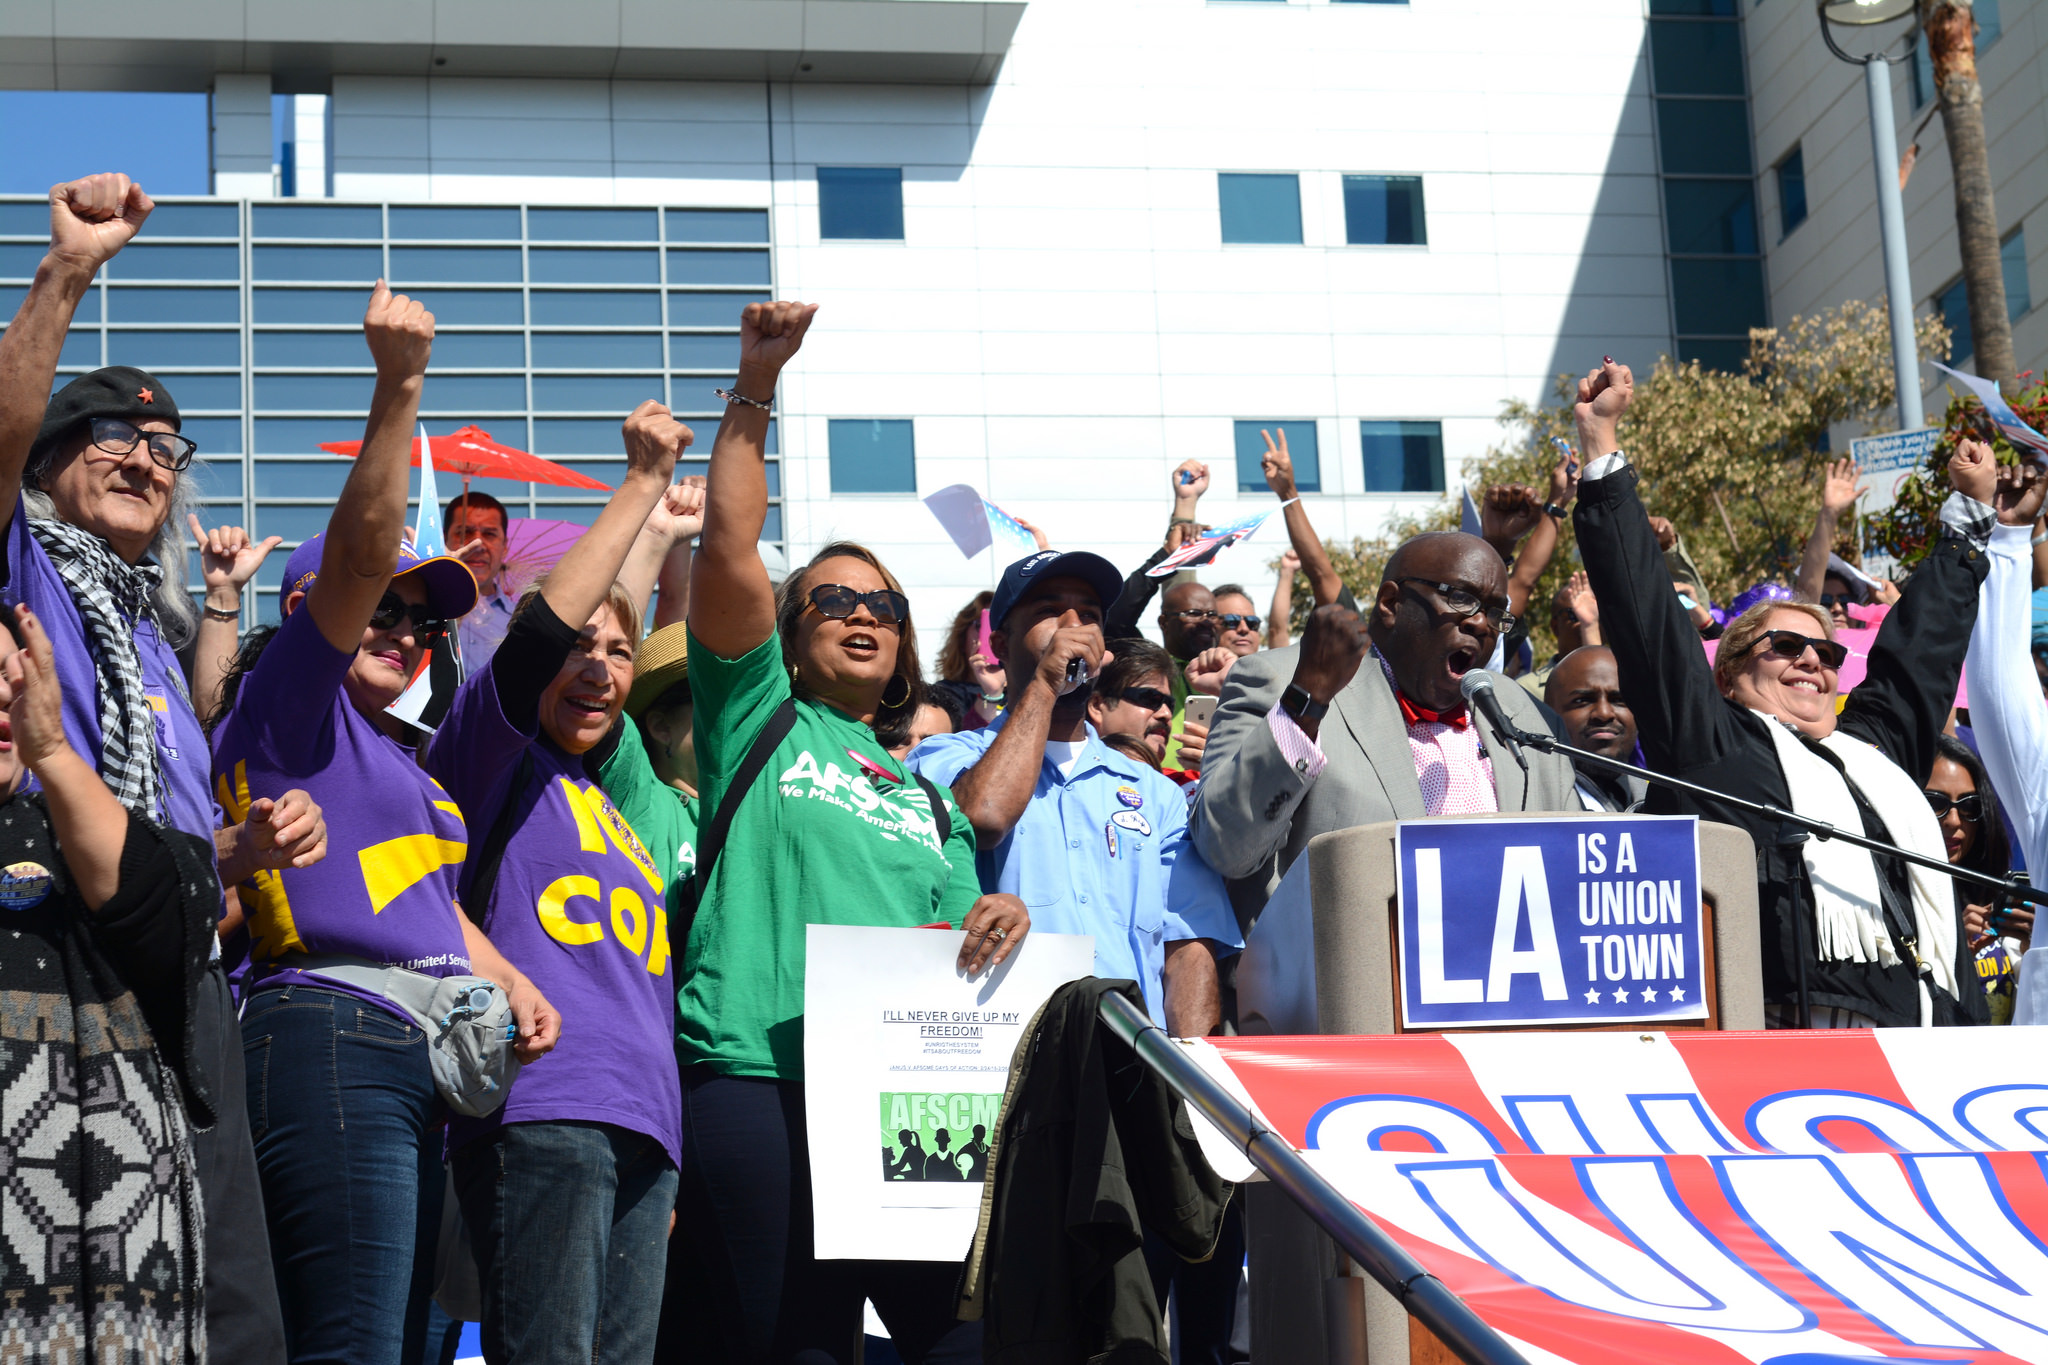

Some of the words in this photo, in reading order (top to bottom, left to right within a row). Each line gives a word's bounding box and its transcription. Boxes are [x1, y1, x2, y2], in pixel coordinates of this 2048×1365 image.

[1904, 434, 1926, 447] you
[779, 784, 804, 797] We
[807, 786, 853, 812] Make
[1578, 832, 1608, 874] IS
[1615, 832, 1638, 873] A
[1578, 880, 1683, 926] UNION
[1415, 845, 1569, 1005] LA
[407, 953, 447, 971] United
[1579, 933, 1685, 982] TOWN
[883, 1010, 904, 1021] I'LL
[907, 1010, 948, 1022] NEVER
[951, 1011, 979, 1022] GIVE
[983, 1012, 999, 1022] UP
[1002, 1012, 1020, 1023] MY
[920, 1025, 983, 1037] FREEDOM!
[888, 1093, 1008, 1132] AFSCM
